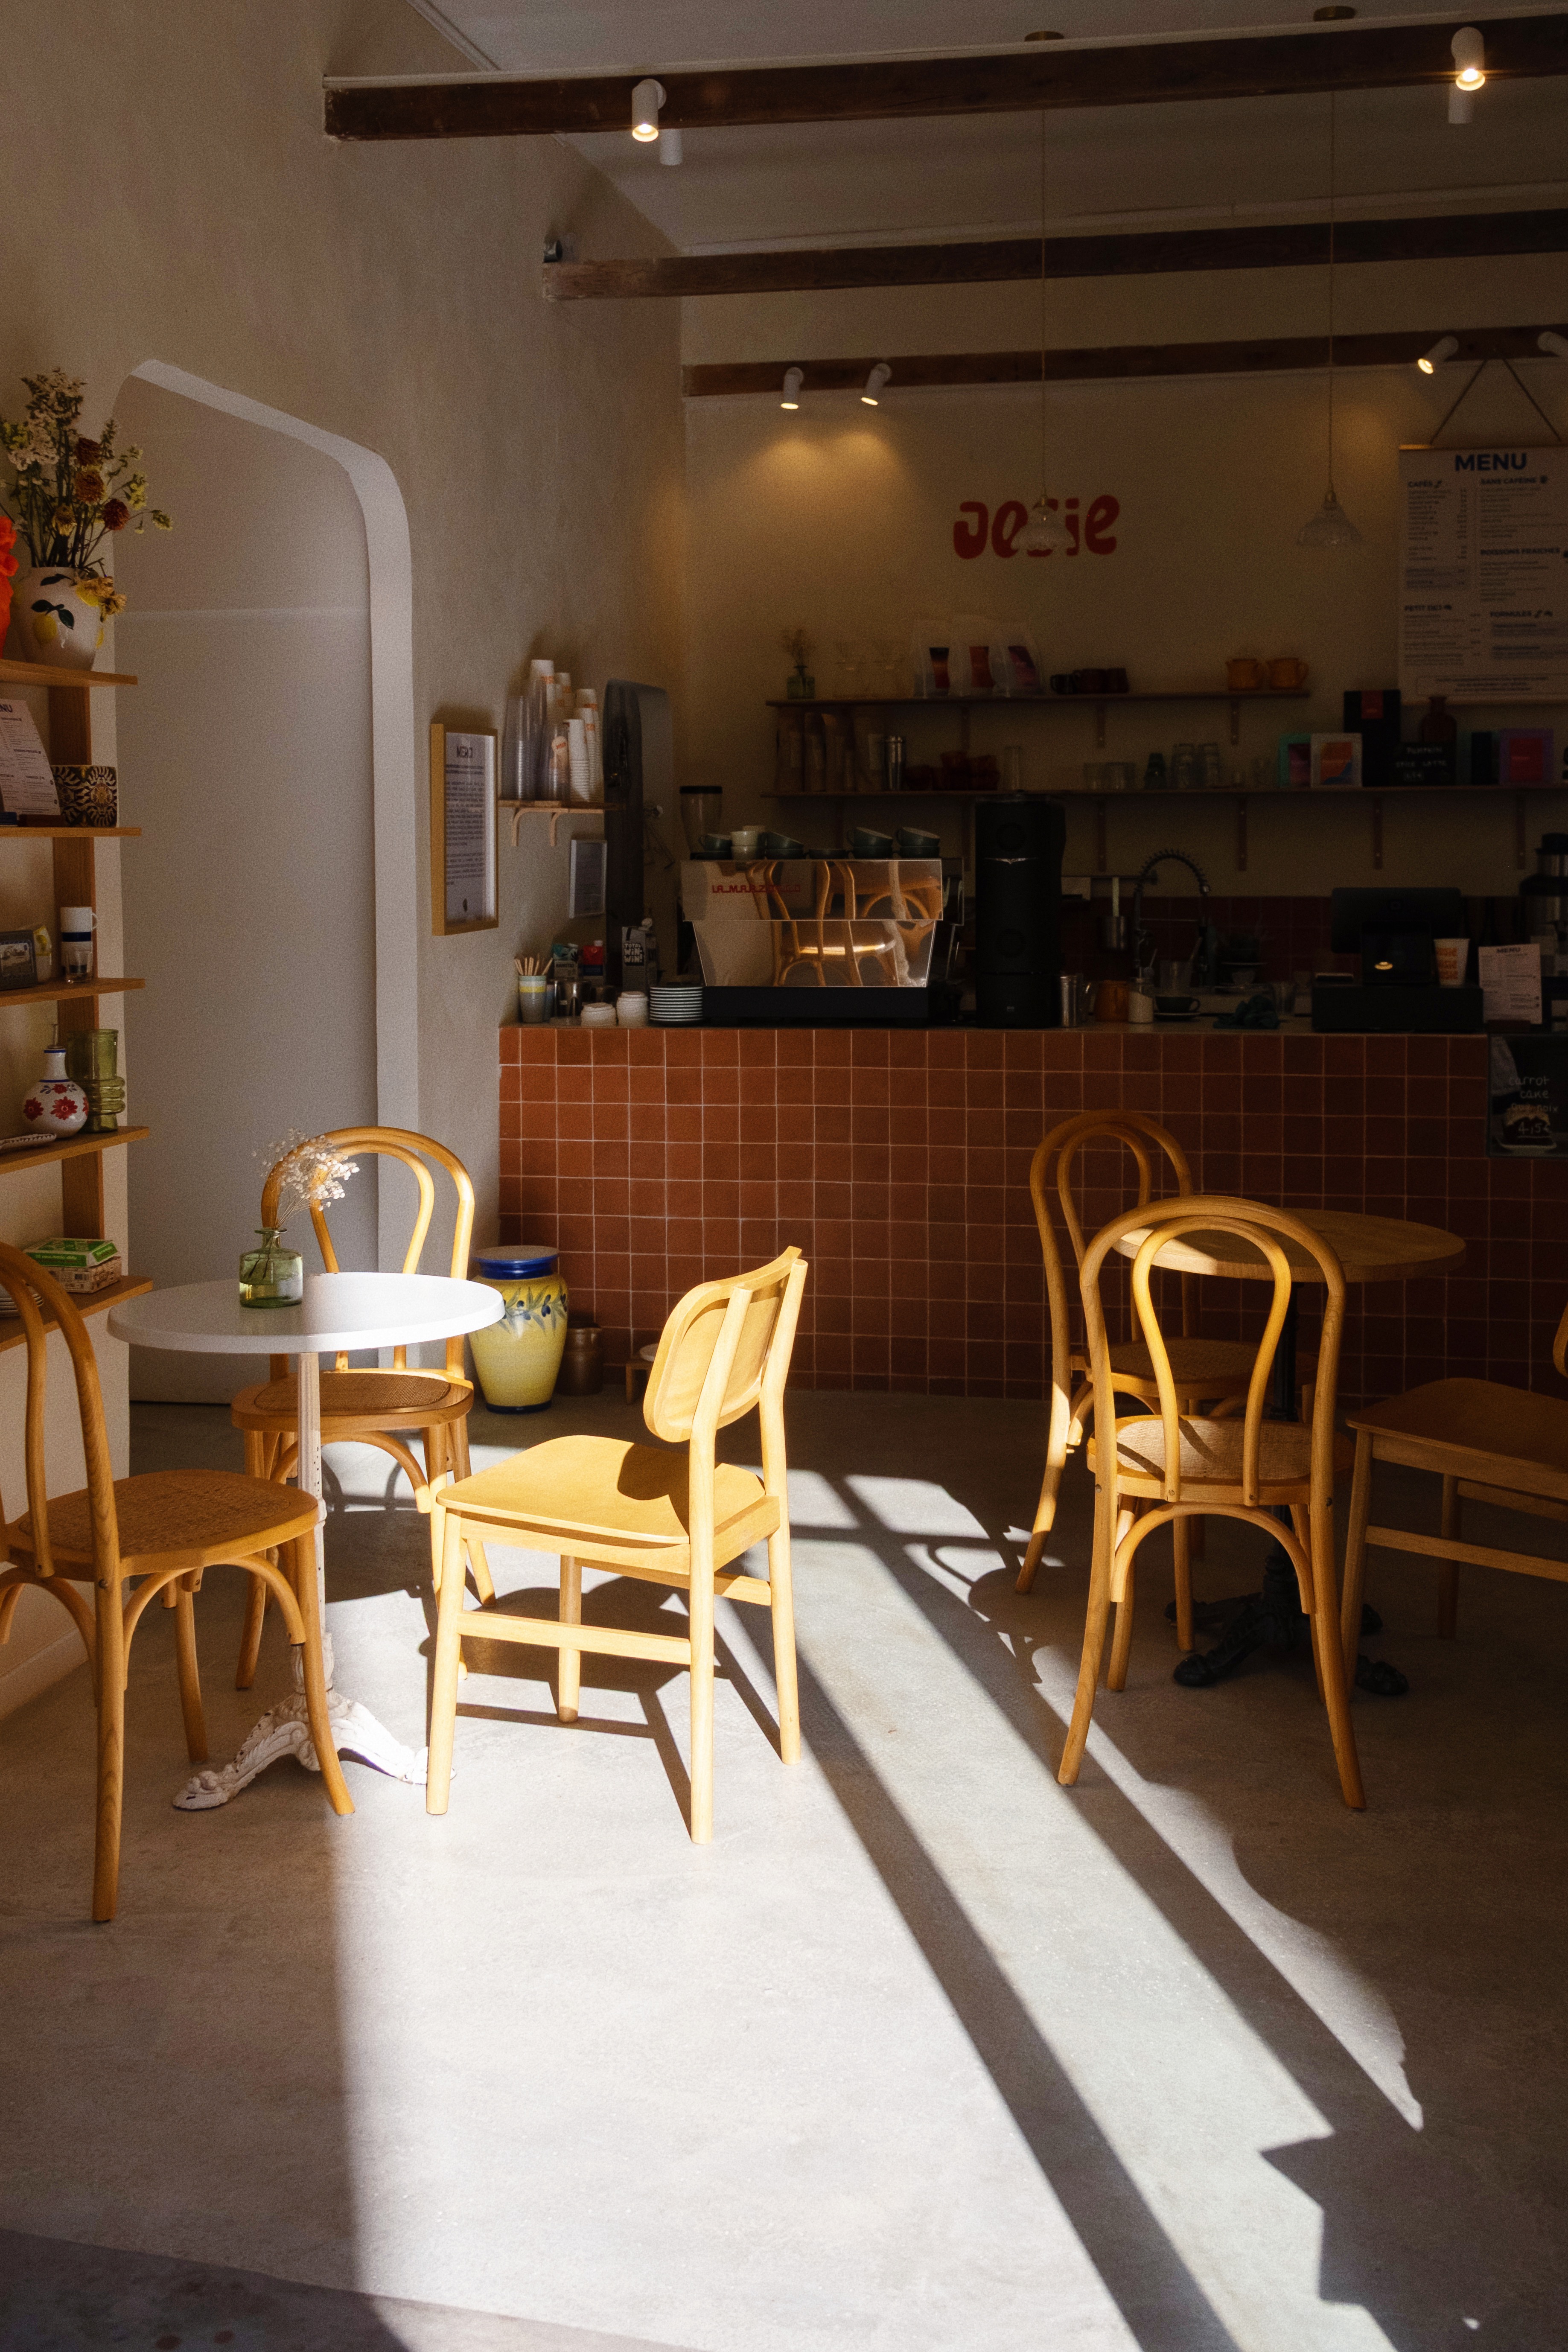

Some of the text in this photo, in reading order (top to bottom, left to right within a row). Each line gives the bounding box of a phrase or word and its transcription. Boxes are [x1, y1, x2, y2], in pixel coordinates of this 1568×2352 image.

[1455, 453, 1527, 471] MENU
[1508, 1075, 1550, 1086] carrot
[1520, 1090, 1550, 1099] cake
